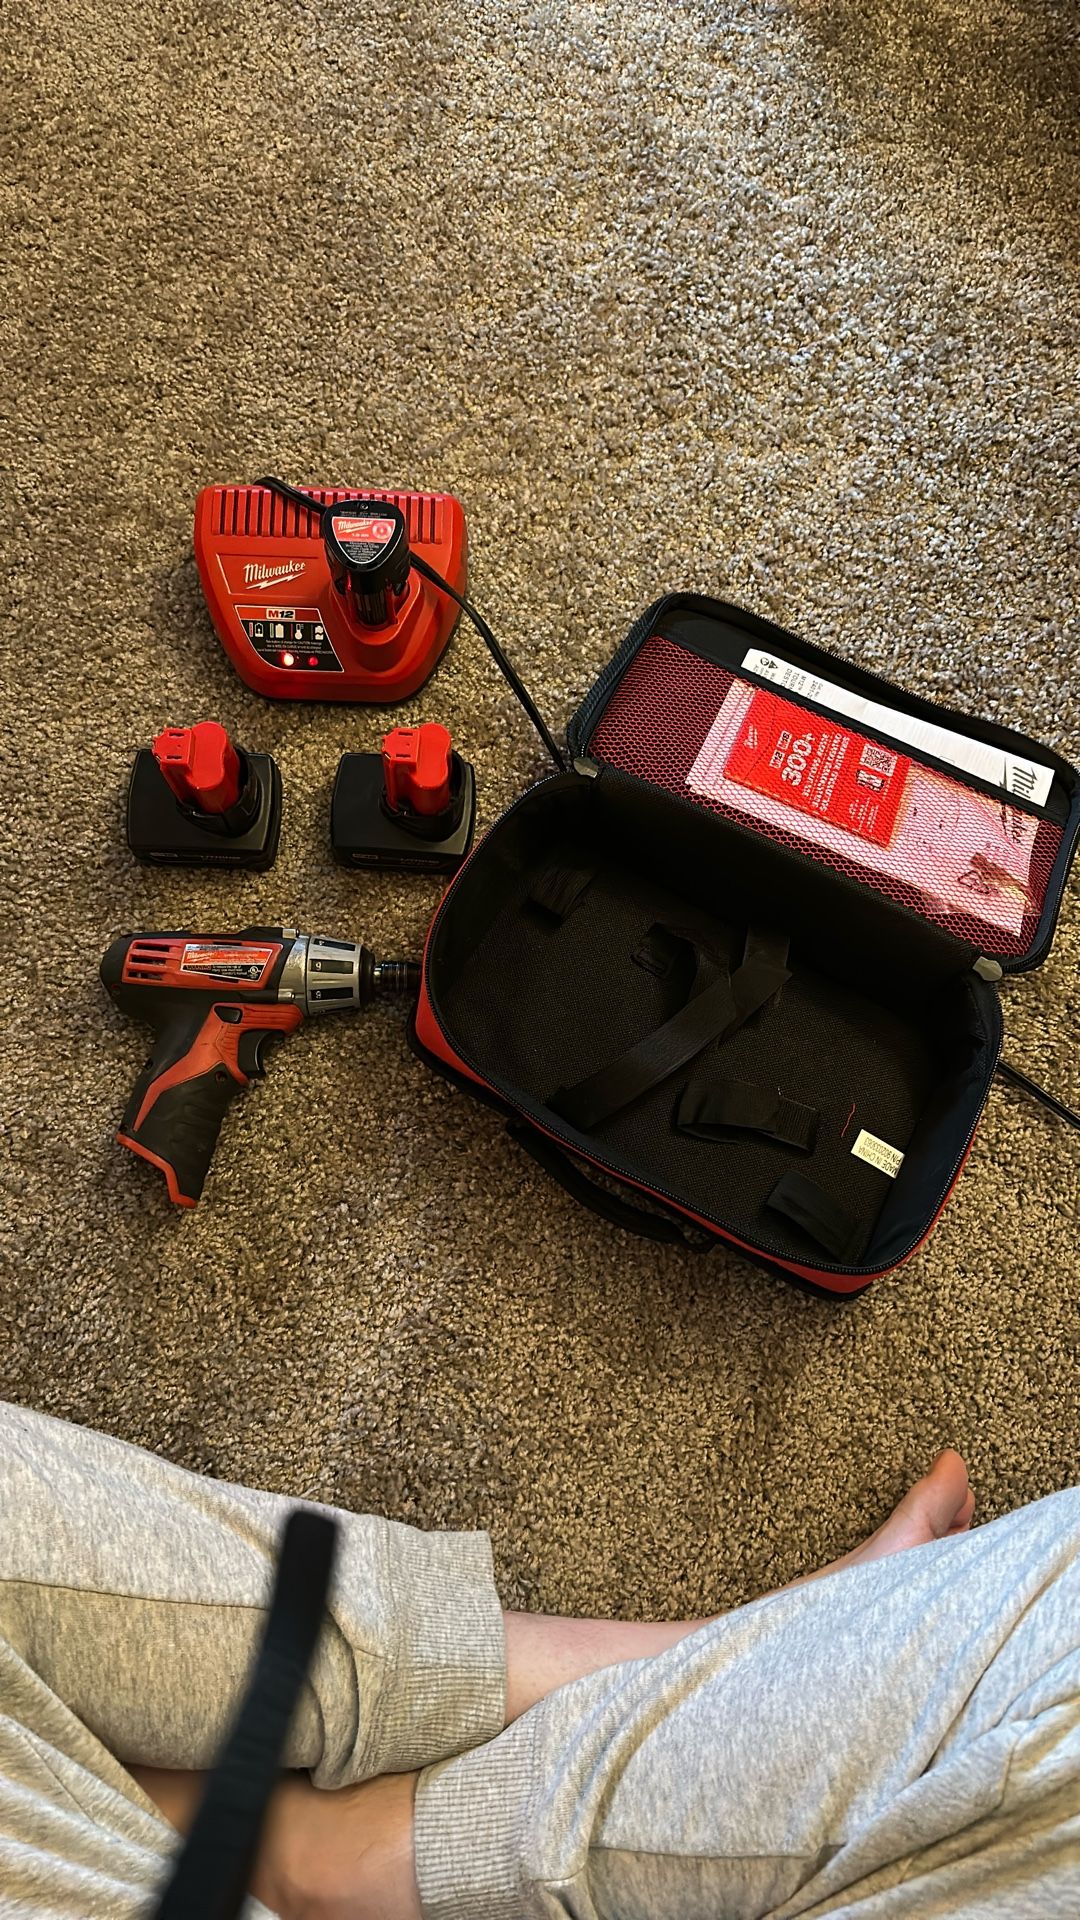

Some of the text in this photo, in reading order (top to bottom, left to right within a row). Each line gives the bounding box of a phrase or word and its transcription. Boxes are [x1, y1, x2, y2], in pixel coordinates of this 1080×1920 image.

[243, 560, 306, 583] Milwaukee
[268, 610, 294, 619] M12
[781, 733, 816, 786] 300+
[881, 1159, 898, 1176] MADE
